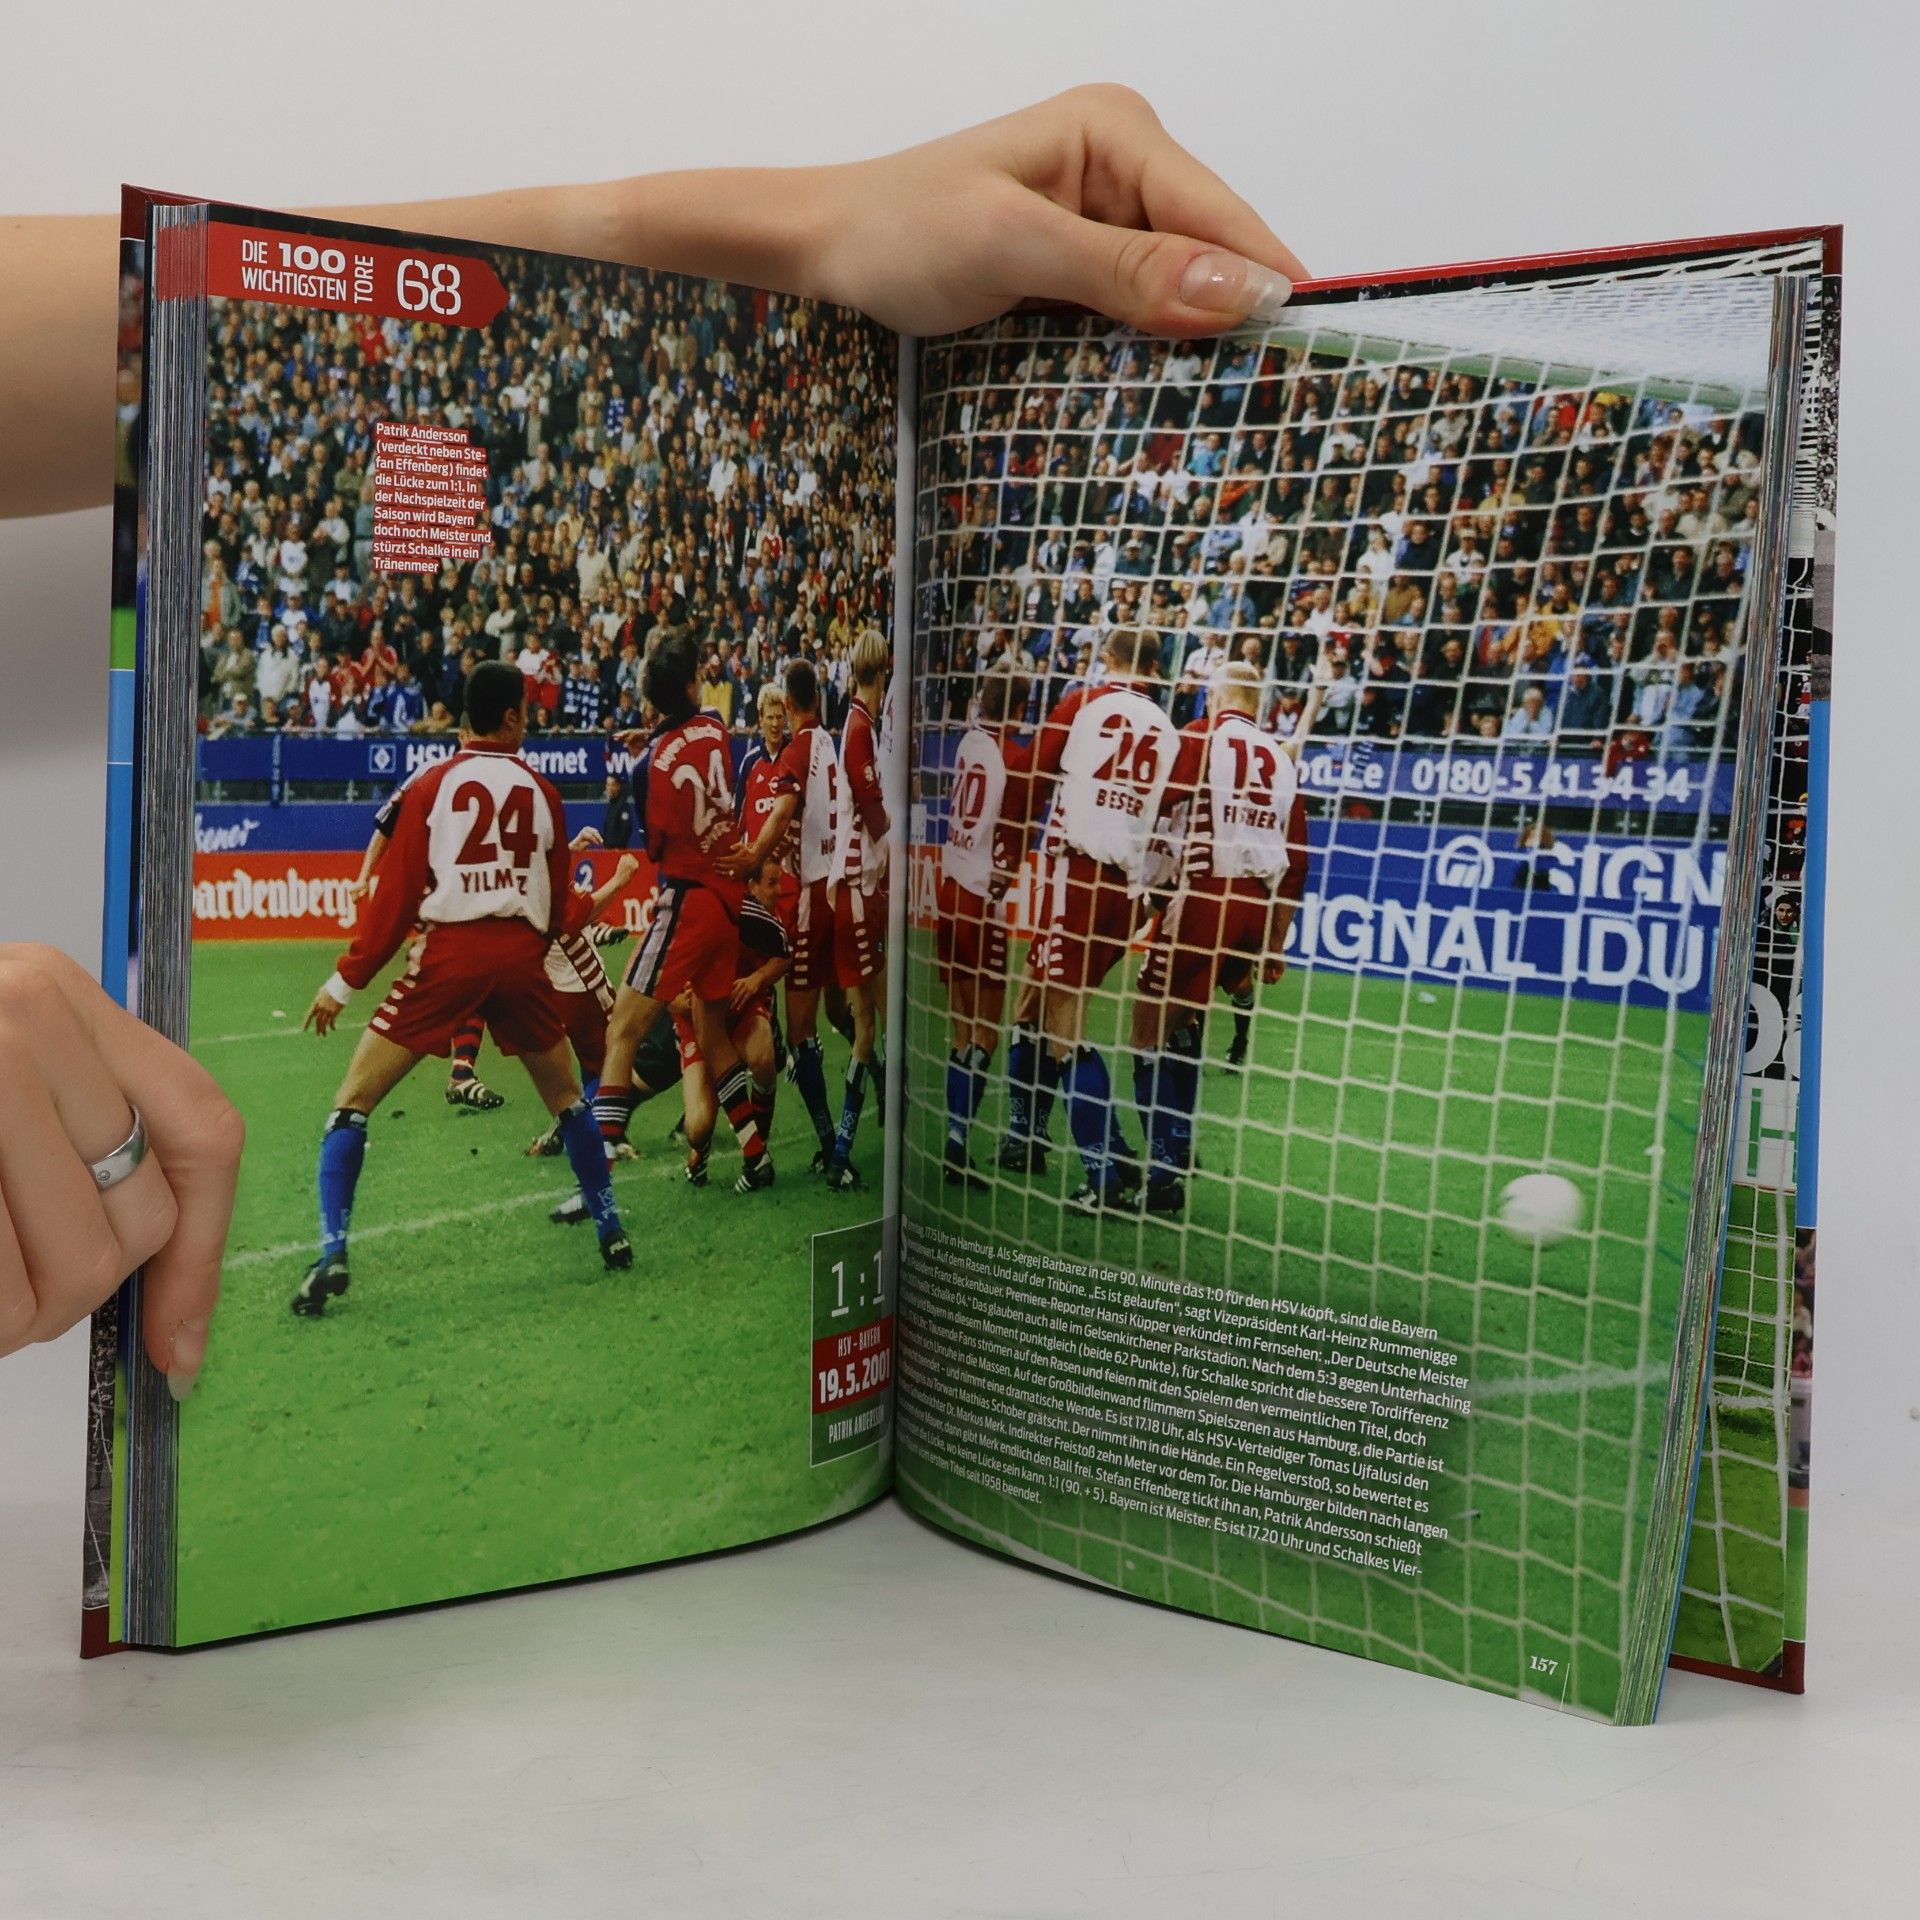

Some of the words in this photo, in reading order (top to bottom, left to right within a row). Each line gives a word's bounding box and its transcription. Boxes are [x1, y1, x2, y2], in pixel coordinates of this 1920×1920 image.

[241, 266, 347, 302] WICHTIGSTEN
[242, 239, 268, 264] DIE
[278, 242, 346, 274] 100
[354, 254, 374, 304] TORE
[396, 258, 462, 316] 68
[377, 423, 409, 438] Patrik
[411, 427, 467, 442] Andersson
[377, 440, 428, 456] (verdeckt
[430, 446, 462, 459] neben
[464, 448, 486, 460] Ste-
[376, 456, 394, 470] fan
[396, 459, 453, 476] Effenberg)
[456, 465, 487, 478] findet
[376, 474, 391, 486] die
[394, 475, 424, 488] Lücke
[426, 480, 448, 491] zum
[450, 480, 465, 492] 1:1.
[467, 481, 477, 493] In
[374, 507, 411, 521] Saison
[413, 511, 436, 523] wird
[438, 512, 474, 526] Bayern
[375, 491, 392, 502] der
[394, 492, 466, 509] Nachspielzeit
[468, 499, 485, 510] der
[373, 541, 406, 554] stürzt
[408, 542, 450, 557] Schalke
[451, 546, 461, 558] in
[463, 548, 479, 559] ein
[374, 524, 400, 536] doch
[402, 527, 428, 539] noch
[430, 528, 470, 541] Meister
[471, 532, 492, 543] und
[373, 557, 439, 572] Tränenmeer
[1092, 714, 1161, 795] 26
[670, 748, 733, 837] 24
[452, 780, 538, 868] 24
[1283, 892, 1536, 977] IGNAL
[1140, 1275, 1180, 1294] Minute
[1182, 1282, 1204, 1298] das
[1226, 1289, 1243, 1305] für
[1245, 1293, 1268, 1309] den
[1271, 1297, 1299, 1314] HSV
[1300, 1302, 1337, 1324] köpft,
[1339, 1311, 1367, 1327] sind
[1369, 1315, 1389, 1331] die
[1391, 1319, 1437, 1340] Bayern
[1184, 1306, 1211, 1321] sagt
[1213, 1308, 1298, 1336] Vizepräsident
[1300, 1324, 1367, 1349] Karl-Heinz
[1369, 1336, 1457, 1366] Rummenigge
[838, 1336, 852, 1358] HSV
[859, 1325, 880, 1350] BAYERN
[1172, 1324, 1233, 1345] verkündet
[1235, 1333, 1251, 1348] im
[1253, 1336, 1322, 1361] Fernsehen:
[1355, 1355, 1416, 1379] Deutsche
[1419, 1367, 1469, 1389] Meister
[819, 1348, 890, 1404] 19.5.2001
[1173, 1342, 1249, 1369] Parkstadion.
[1252, 1357, 1284, 1376] Nach
[1286, 1364, 1314, 1381] dem
[1316, 1369, 1337, 1385] 5:3
[1338, 1376, 1378, 1393] gegen
[1381, 1381, 1471, 1414] Unterhaching
[1182, 1364, 1199, 1379] für
[1200, 1368, 1249, 1389] Schalke
[1250, 1380, 1294, 1398] spricht
[1296, 1387, 1315, 1402] die
[1318, 1390, 1367, 1412] bessere
[1370, 1400, 1449, 1429] Tordifferenz
[829, 1416, 853, 1444] PATRIK
[1138, 1377, 1157, 1392] mit
[1159, 1380, 1181, 1396] den
[1183, 1385, 1232, 1407] Spielern
[1234, 1396, 1258, 1412] den
[1260, 1403, 1355, 1432] vermeintlichen
[1358, 1419, 1391, 1441] Titel,
[1394, 1427, 1426, 1446] doch
[1142, 1397, 1195, 1420] flimmern
[1197, 1409, 1270, 1436] Spielszenen
[1272, 1427, 1295, 1441] aus
[1297, 1429, 1360, 1456] Hamburg,
[1363, 1443, 1383, 1459] die
[1385, 1447, 1425, 1468] Partie
[1427, 1455, 1444, 1472] ist
[1148, 1439, 1159, 1453] in
[1161, 1442, 1179, 1458] die
[1181, 1446, 1222, 1468] Hände.
[1225, 1456, 1244, 1473] Ein
[1246, 1460, 1332, 1494] Regelverstoß,
[1335, 1483, 1350, 1495] so
[1352, 1483, 1412, 1509] bewertet
[1414, 1500, 1428, 1512] es
[1161, 1421, 1184, 1440] Uhr,
[1186, 1428, 1204, 1443] als
[1206, 1431, 1305, 1464] HSV-Verteidiger
[1308, 1452, 1349, 1473] Tomas
[1352, 1461, 1402, 1485] Ujfalusi
[1403, 1473, 1428, 1490] den
[981, 1472, 1001, 1490] 1958
[1002, 1479, 1041, 1504] beendet.
[1159, 1465, 1177, 1478] vor
[1178, 1467, 1205, 1485] dem
[1208, 1473, 1228, 1490] Tor.
[1231, 1478, 1251, 1495] Die
[1253, 1483, 1325, 1511] Hamburger
[1326, 1499, 1367, 1521] bilden
[1369, 1512, 1401, 1528] nach
[1403, 1516, 1448, 1539] langen
[1149, 1500, 1163, 1516] ist
[1166, 1505, 1211, 1528] Meister.
[1214, 1516, 1227, 1532] Es
[1230, 1520, 1245, 1536] ist
[1280, 1532, 1304, 1549] Uhr
[1305, 1540, 1330, 1555] und
[1332, 1544, 1389, 1569] Schalkes
[1392, 1557, 1422, 1576] Vier-
[1192, 1491, 1219, 1509] tickt
[1221, 1497, 1240, 1514] ihn
[1242, 1505, 1261, 1520] an,
[1264, 1507, 1302, 1528] Patrik
[1304, 1516, 1372, 1544] Andersson
[1374, 1534, 1422, 1555] schießt
[1529, 1655, 1558, 1676] 157
